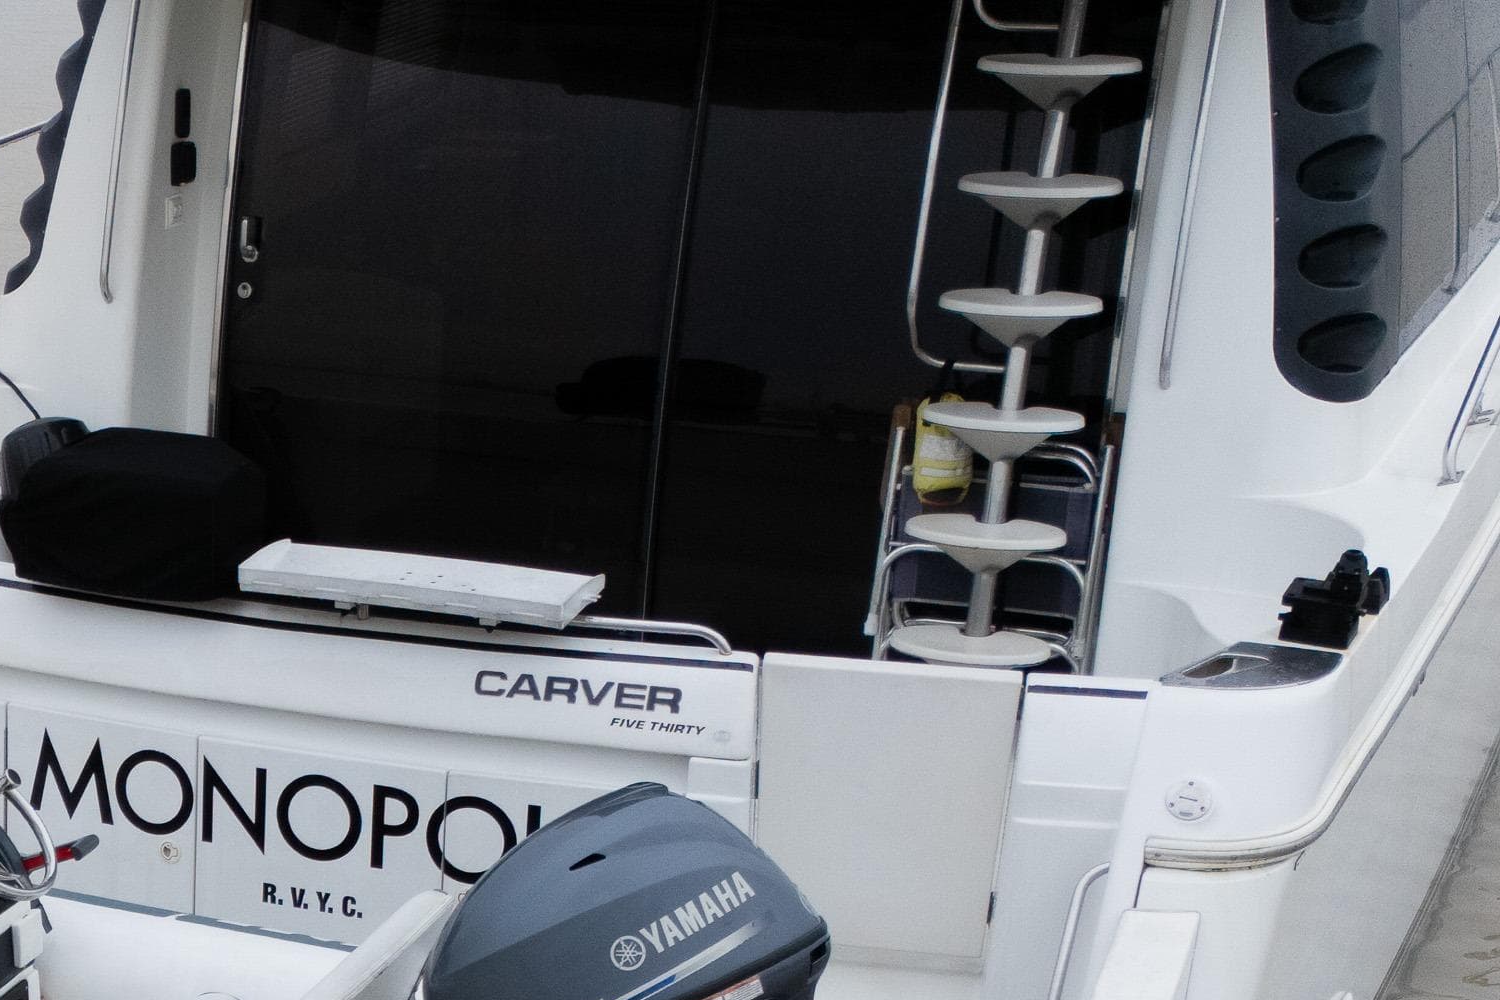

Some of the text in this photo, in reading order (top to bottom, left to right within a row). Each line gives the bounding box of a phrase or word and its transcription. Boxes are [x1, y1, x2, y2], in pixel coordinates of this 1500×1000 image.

[474, 670, 683, 714] CARVER
[610, 717, 706, 736] FIVE THIRTY
[639, 871, 756, 954] YAMAHA
